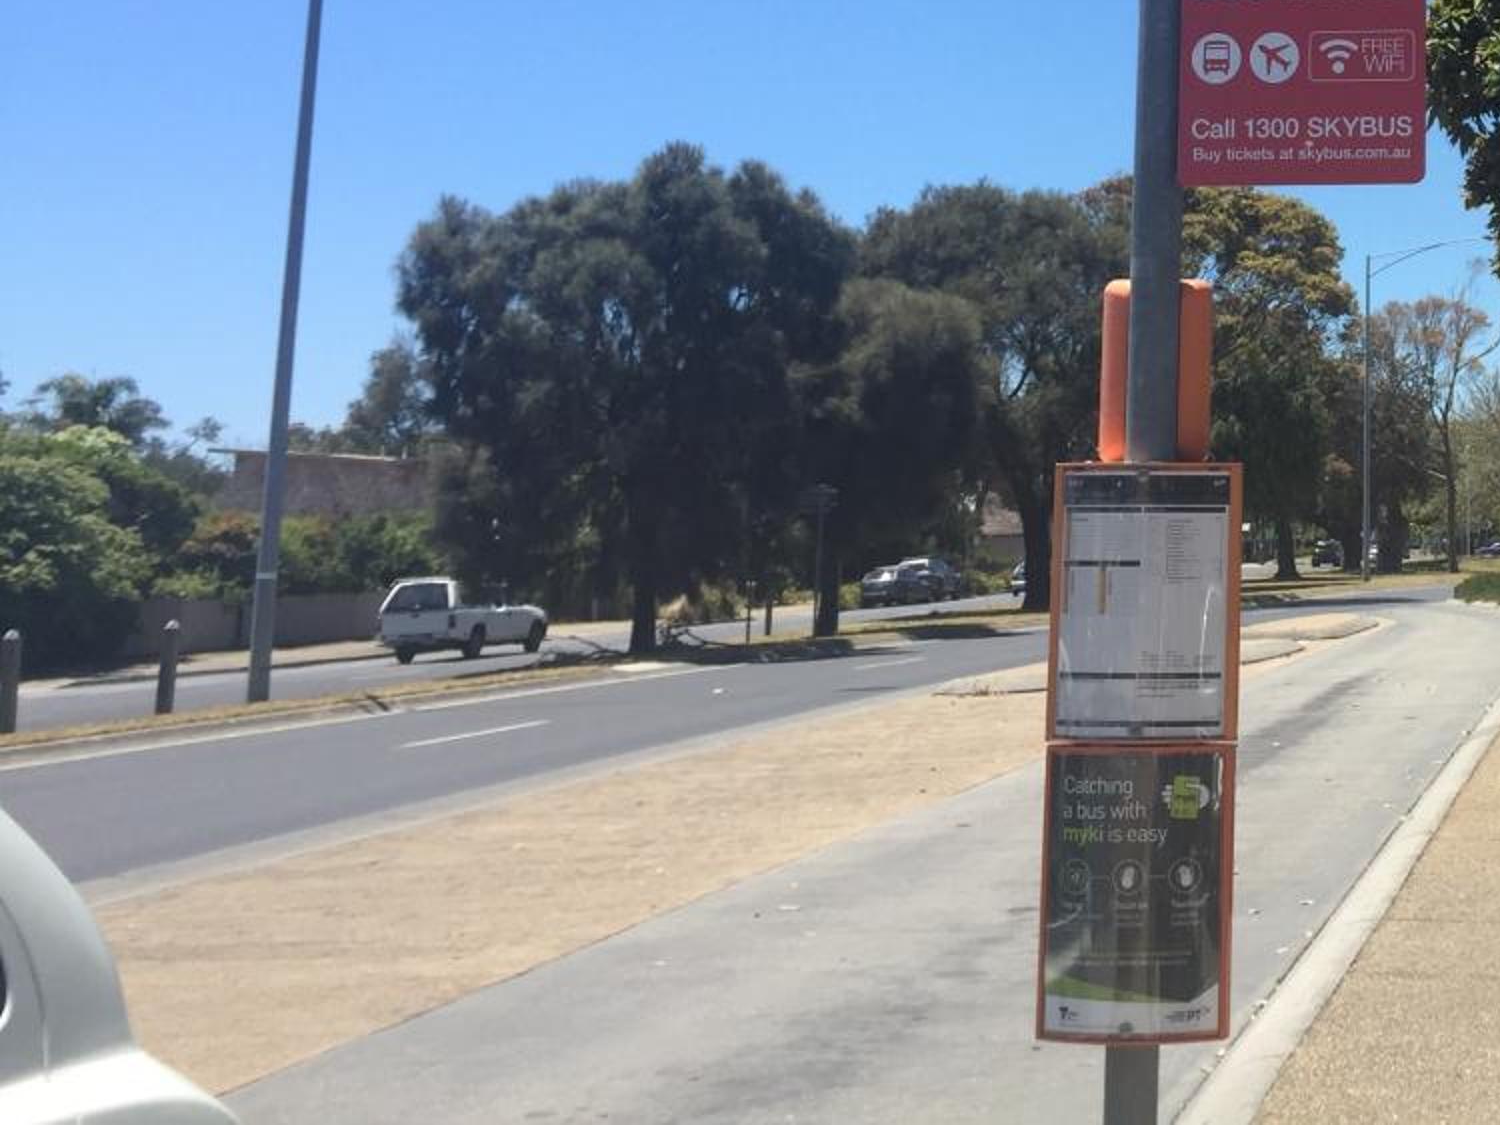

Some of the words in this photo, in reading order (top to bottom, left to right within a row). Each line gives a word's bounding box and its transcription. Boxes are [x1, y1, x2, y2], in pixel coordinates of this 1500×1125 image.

[1361, 38, 1405, 55] FREE
[1191, 118, 1235, 139] Call
[1244, 117, 1299, 138] 1300
[1306, 116, 1413, 138] SKYBUS
[1192, 148, 1221, 163] Buy
[1226, 147, 1275, 161] tickets
[1279, 148, 1294, 160] at
[1298, 146, 1411, 163] skybus.com.au
[1064, 775, 1133, 801] Catching
[1063, 807, 1073, 818] a
[1077, 801, 1106, 819] bus
[1110, 801, 1148, 819] with
[1063, 826, 1104, 846] myki
[1107, 826, 1121, 842] is
[1127, 828, 1168, 847] easy
